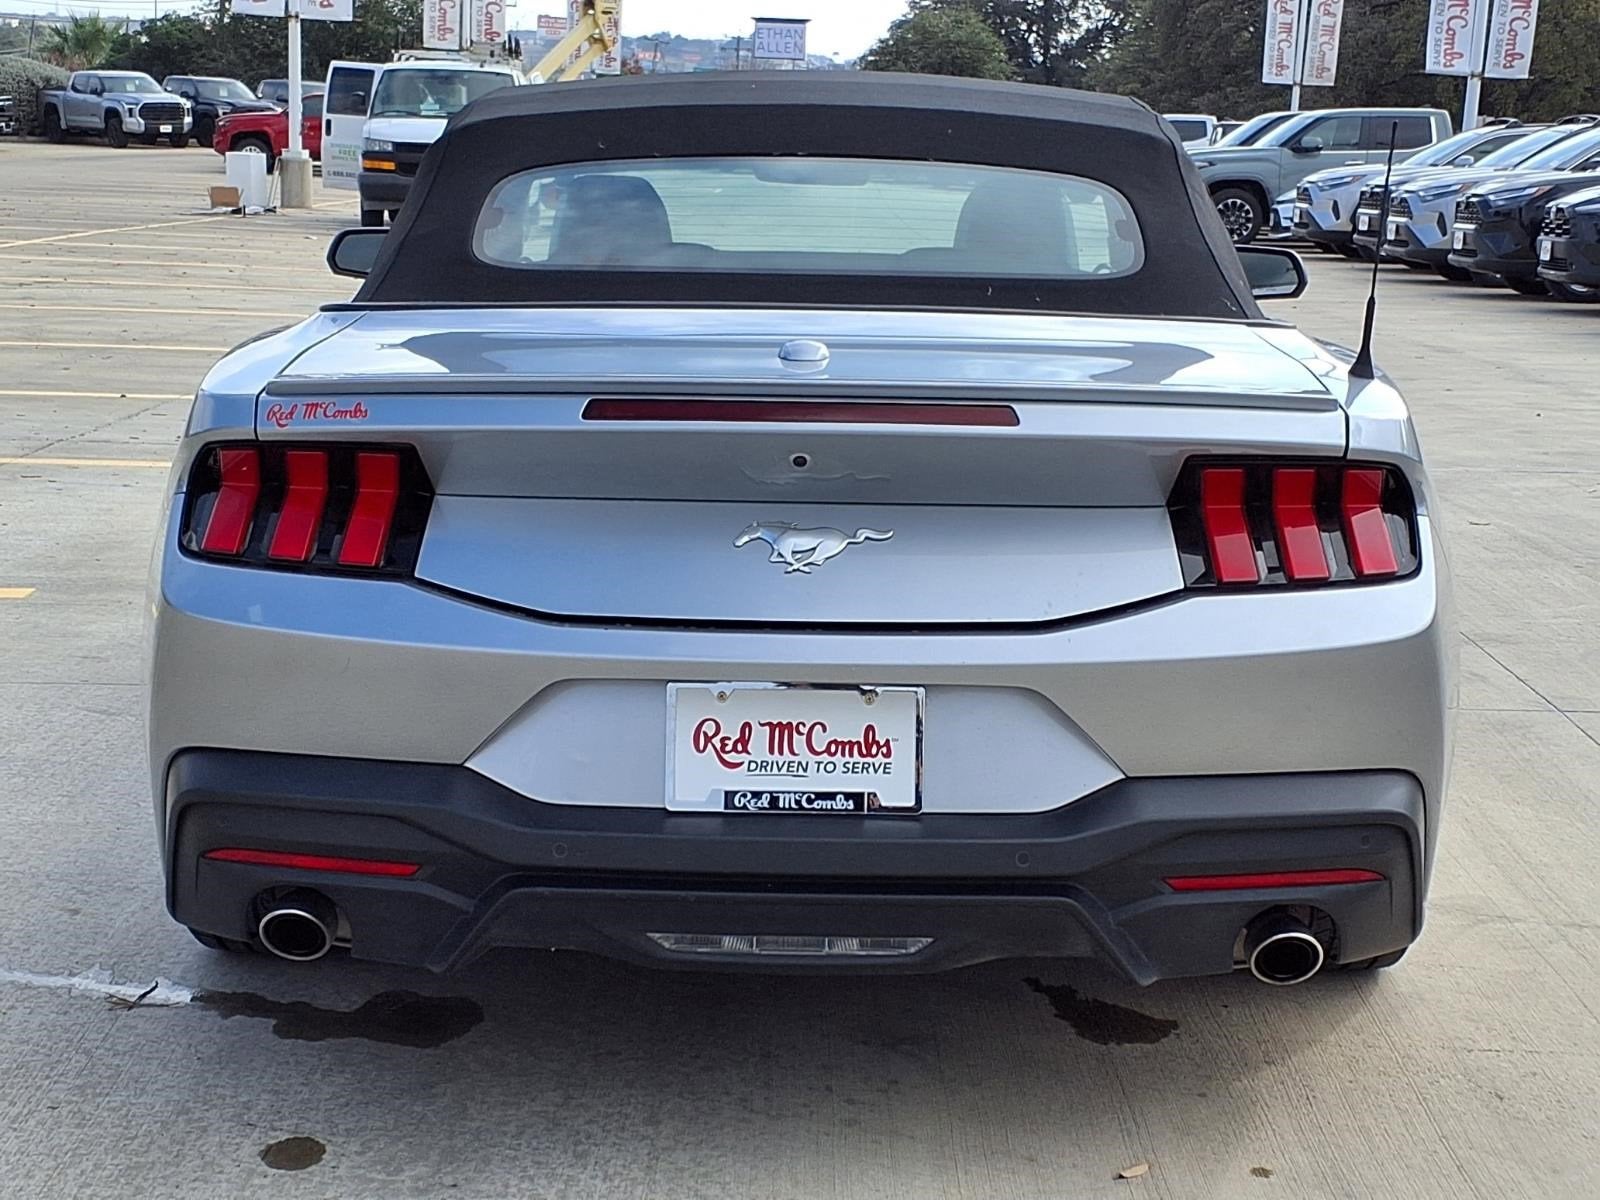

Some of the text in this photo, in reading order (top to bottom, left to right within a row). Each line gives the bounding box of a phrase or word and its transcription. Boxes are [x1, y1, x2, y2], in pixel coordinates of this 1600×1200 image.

[484, 0, 502, 41] Comb
[757, 27, 803, 40] ETHAN
[1434, 21, 1445, 34] TO
[1497, 21, 1507, 35] TO
[757, 41, 803, 54] ALLEN
[1274, 0, 1294, 77] ed McCombs
[1315, 21, 1337, 79] McCombs
[1432, 37, 1442, 67] SERVE
[1492, 38, 1504, 68] SERVE
[266, 401, 368, 428] Red McCombs
[692, 717, 753, 770] Red
[757, 721, 893, 759] McCombs
[746, 760, 893, 775] DRIVEN TO SERVE
[734, 791, 855, 811] Red McCombs
